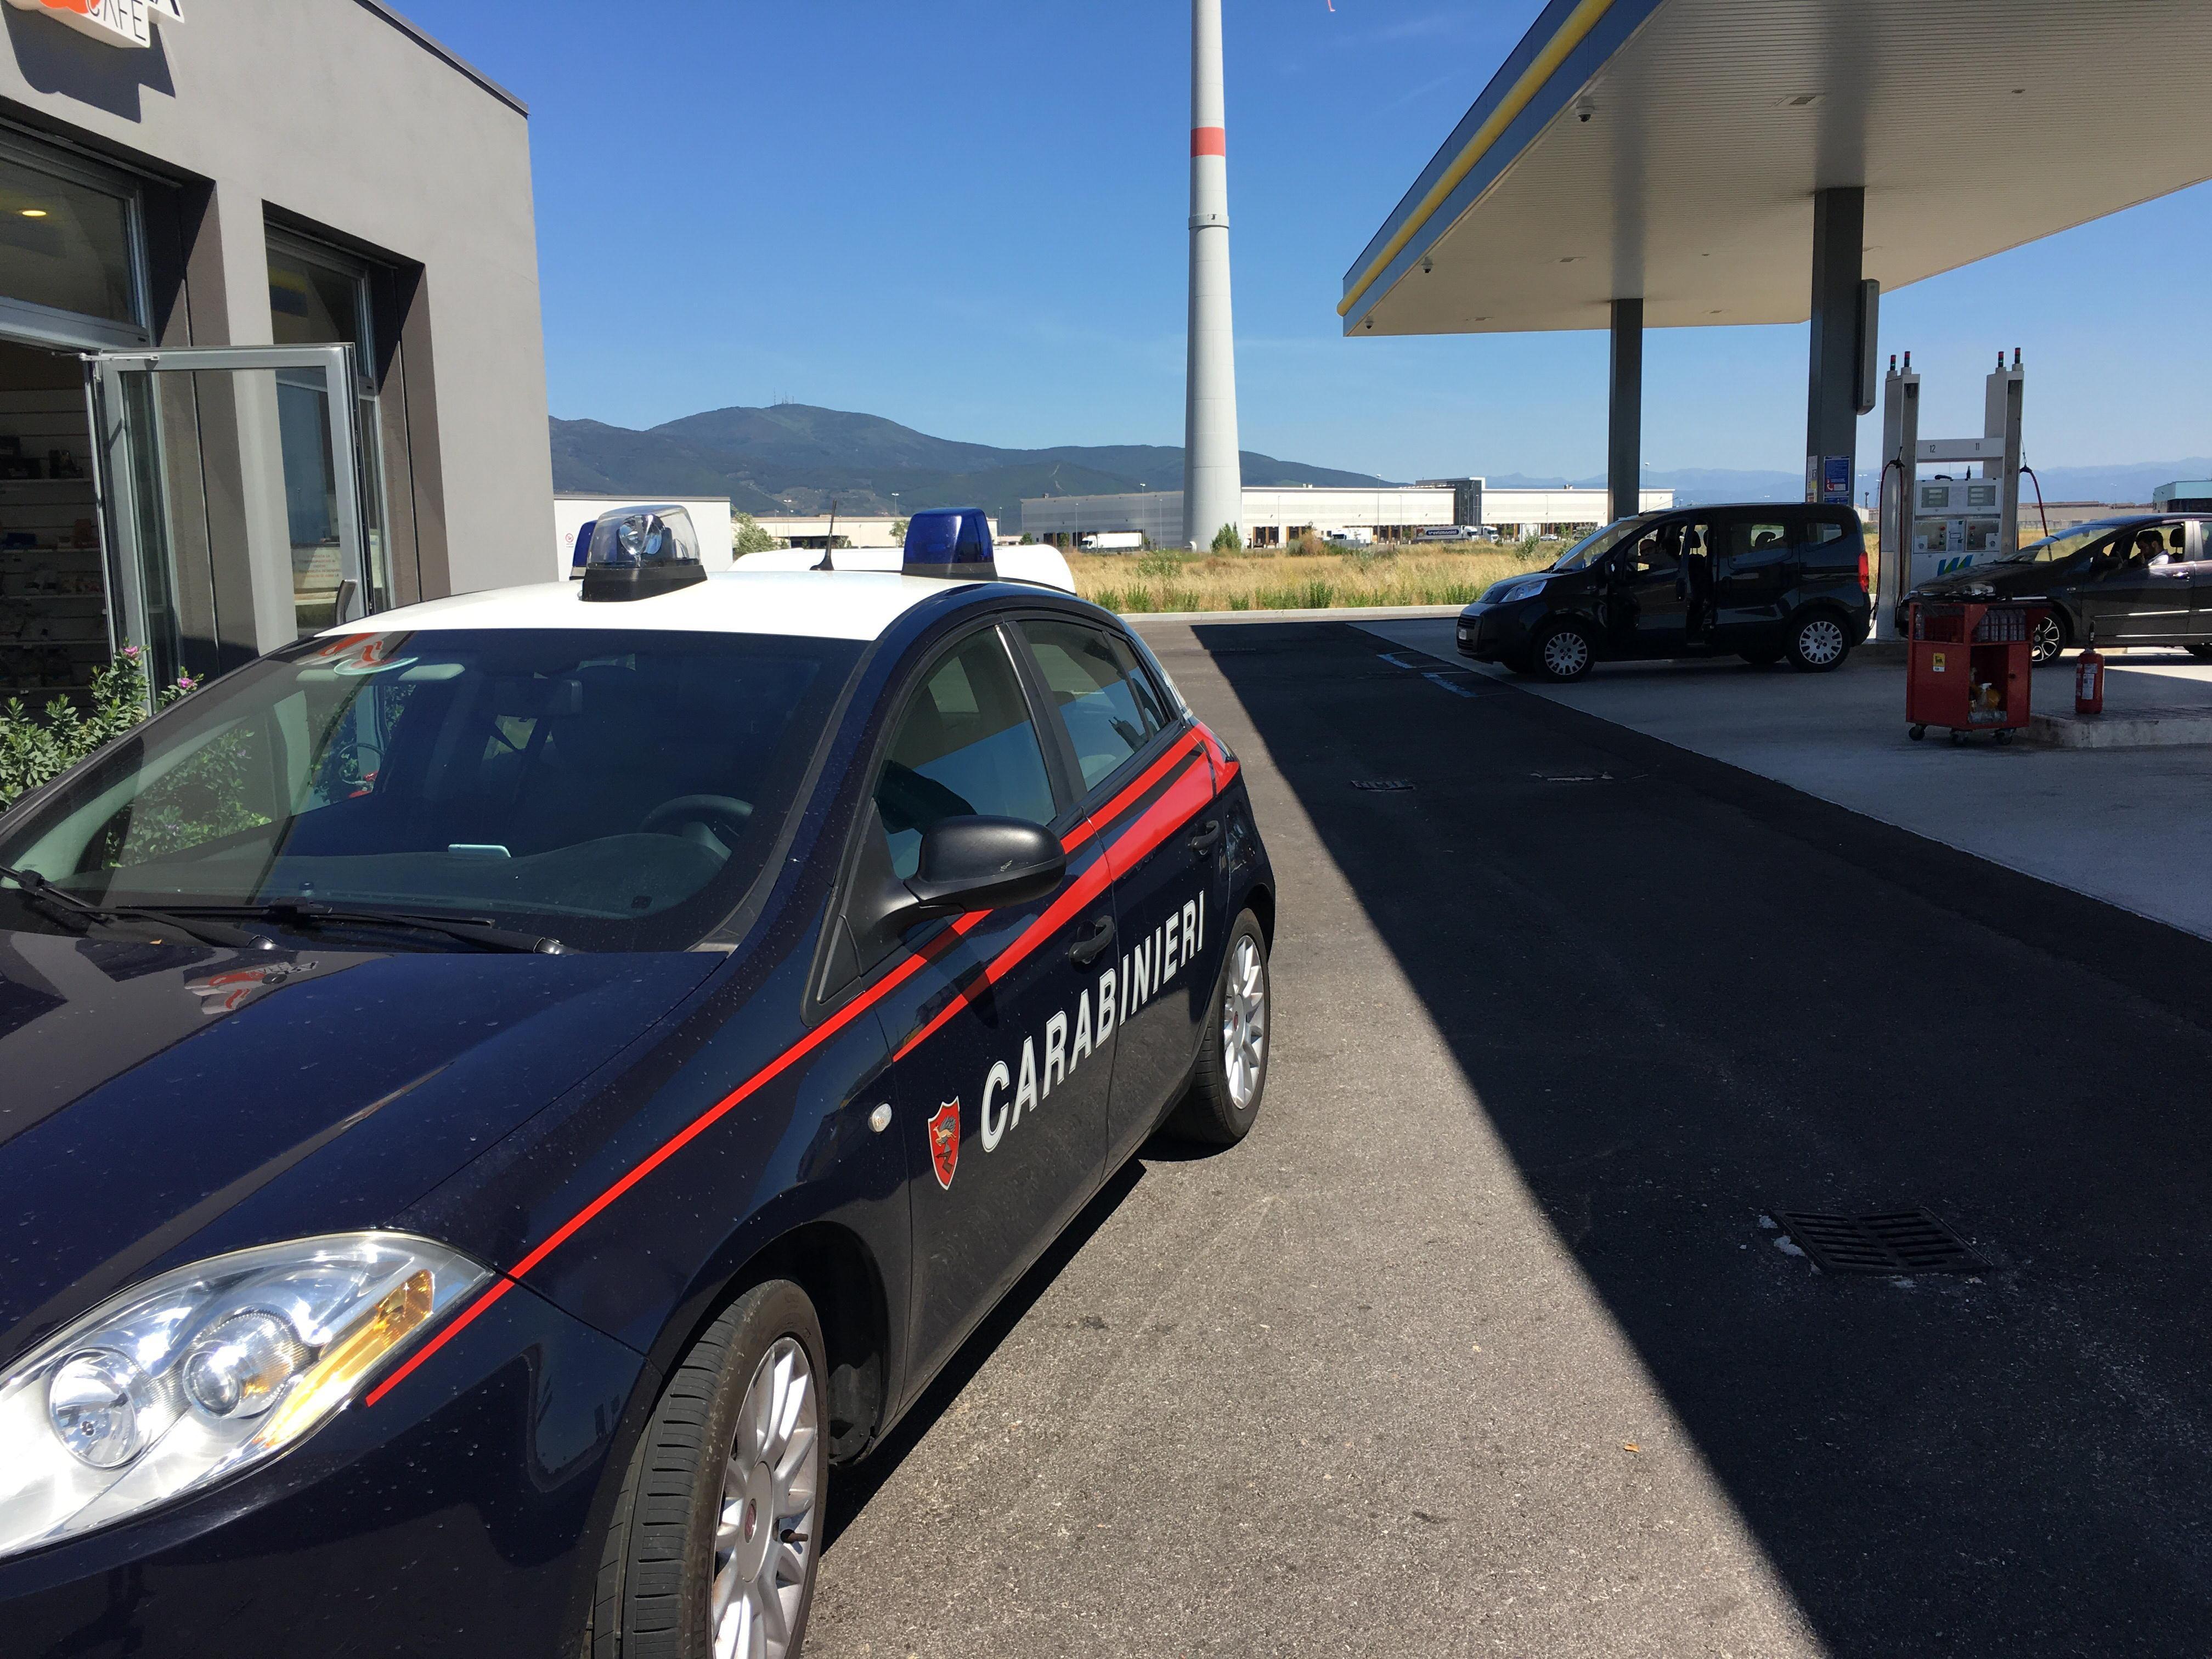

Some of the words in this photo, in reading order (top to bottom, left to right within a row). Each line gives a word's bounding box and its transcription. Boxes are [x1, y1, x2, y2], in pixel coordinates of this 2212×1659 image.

[1929, 444, 1936, 453] 12
[1975, 442, 1980, 450] 11
[981, 890, 1204, 1152] CARABINIERI
